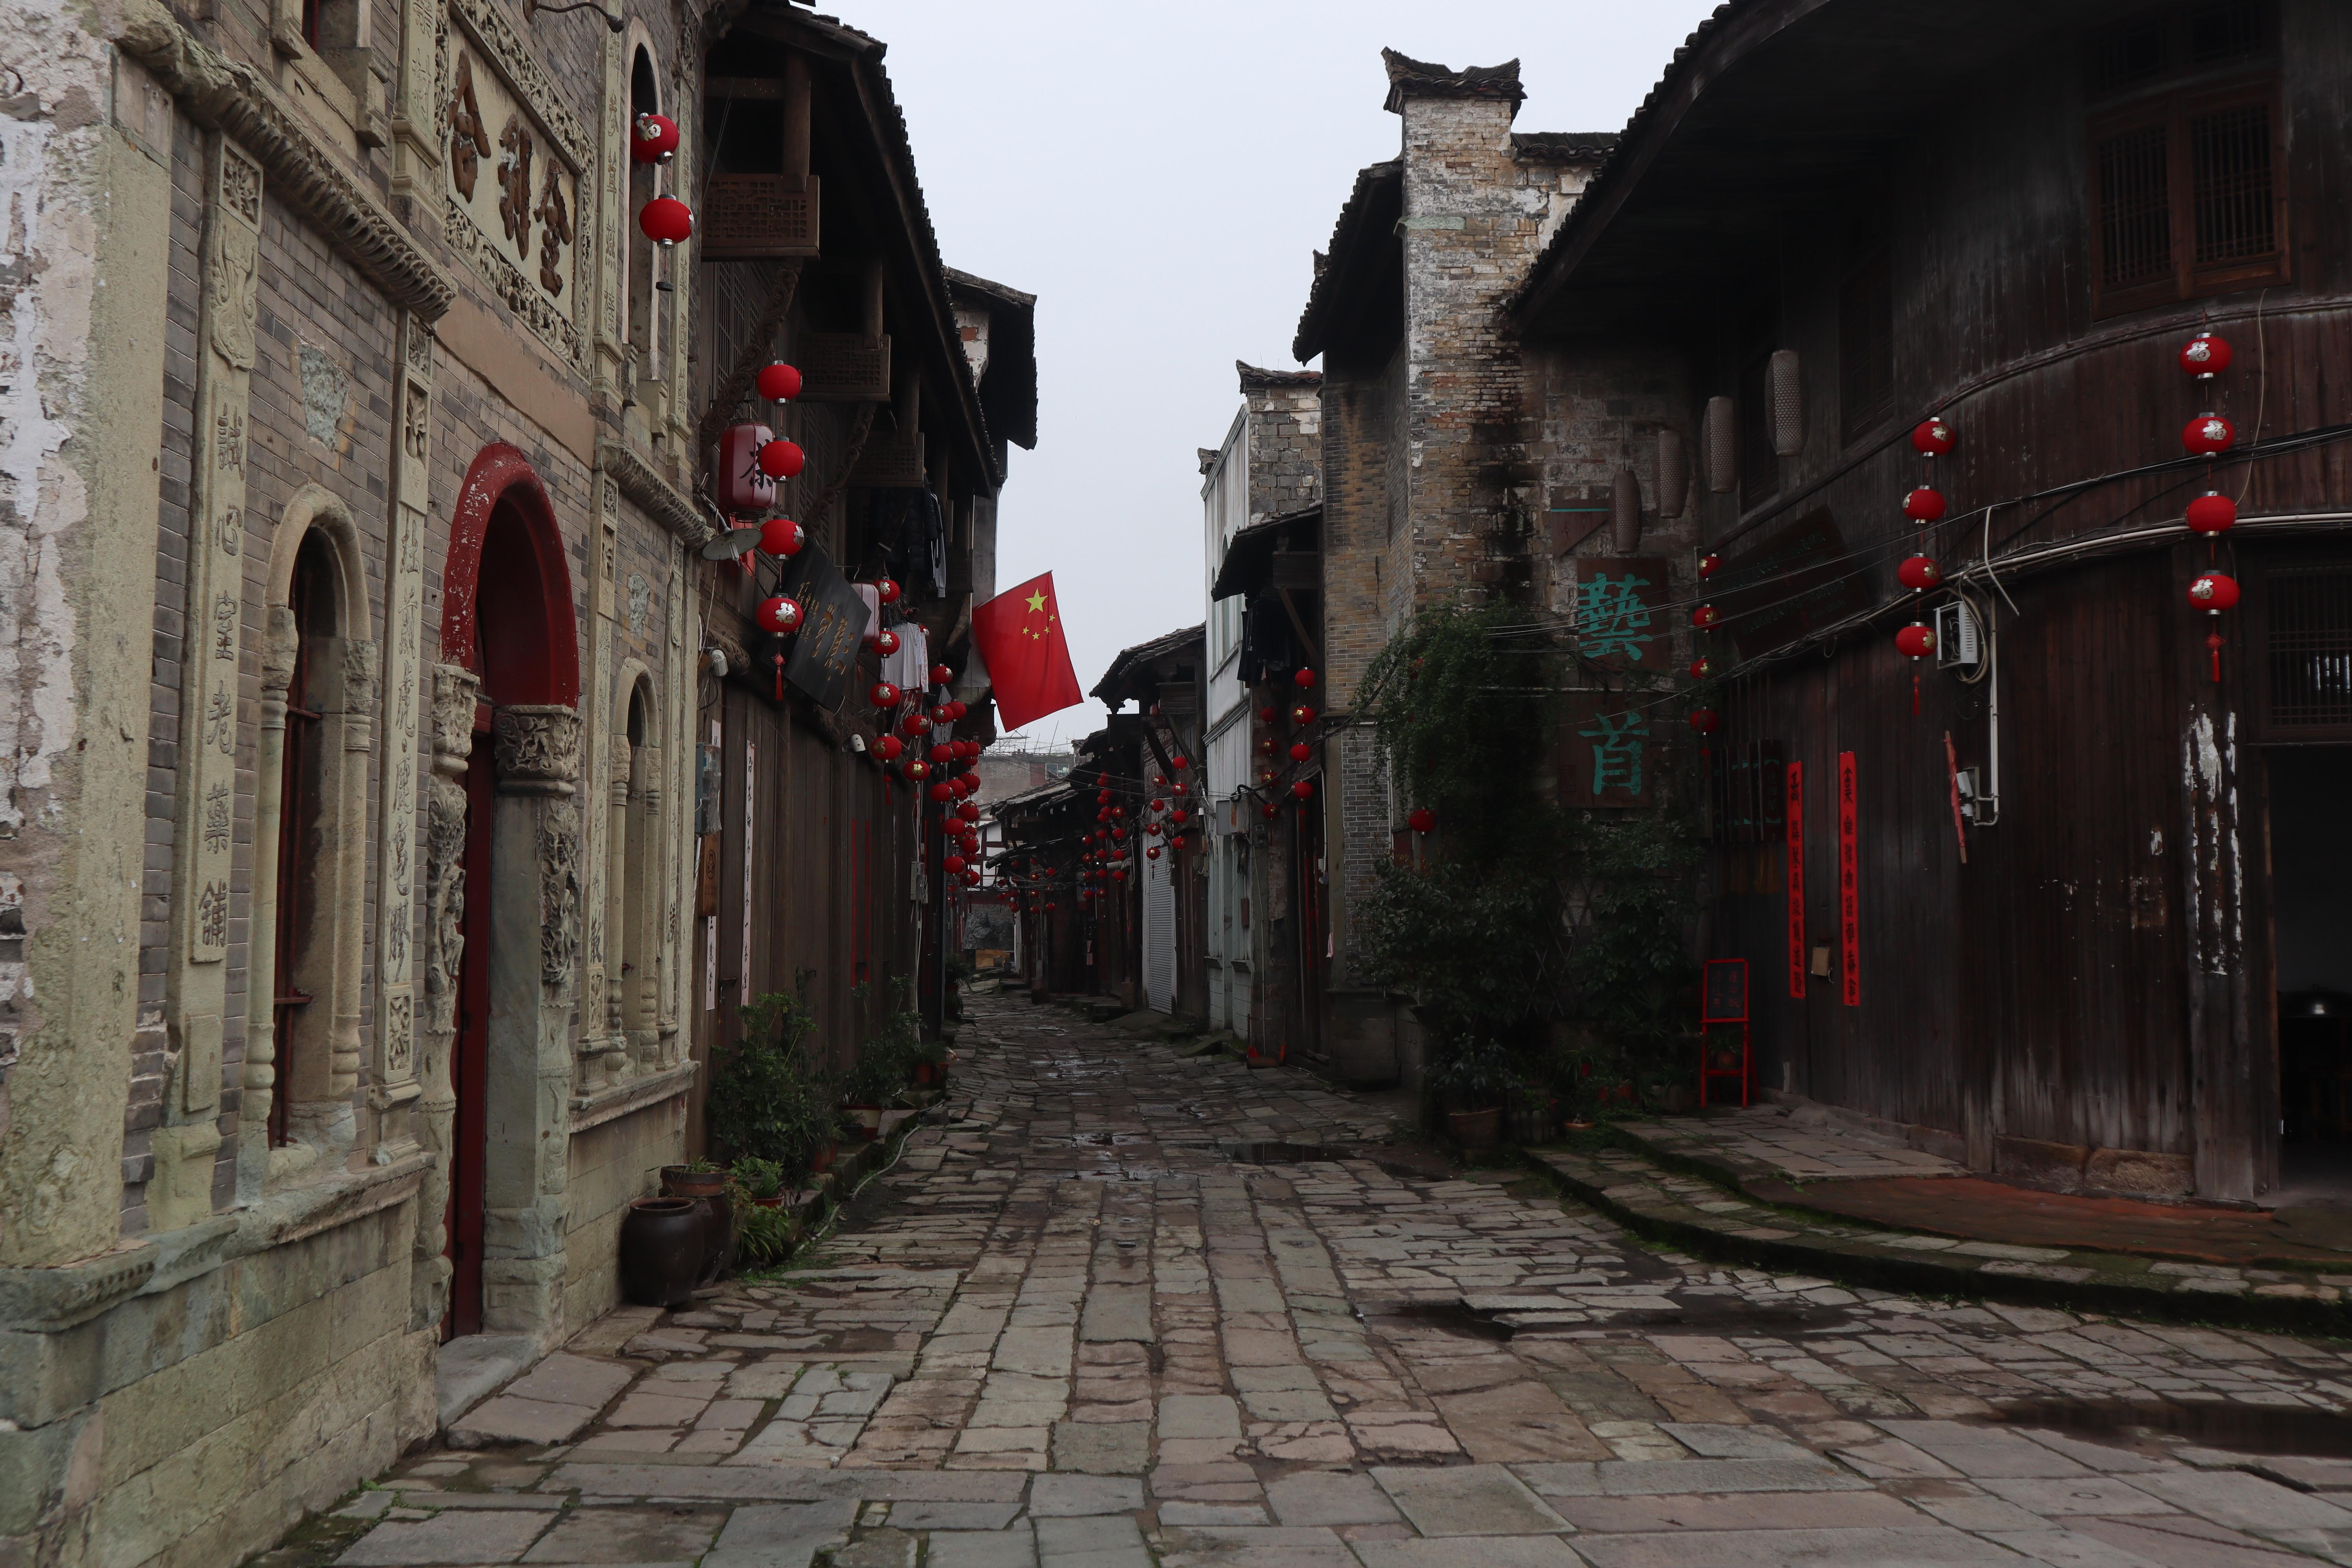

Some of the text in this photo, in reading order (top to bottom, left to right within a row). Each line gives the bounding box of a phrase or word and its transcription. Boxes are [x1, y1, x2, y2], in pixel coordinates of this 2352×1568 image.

[635, 118, 662, 142] 福
[2187, 341, 2211, 362] 福
[2203, 419, 2227, 440] 福
[879, 581, 891, 595] 福
[2192, 579, 2214, 599] 福
[775, 602, 796, 624] 福
[1578, 572, 1653, 661] 藝
[880, 633, 893, 647] 福
[878, 686, 891, 699] 福
[1578, 712, 1650, 795] 首
[911, 764, 924, 775] 福
